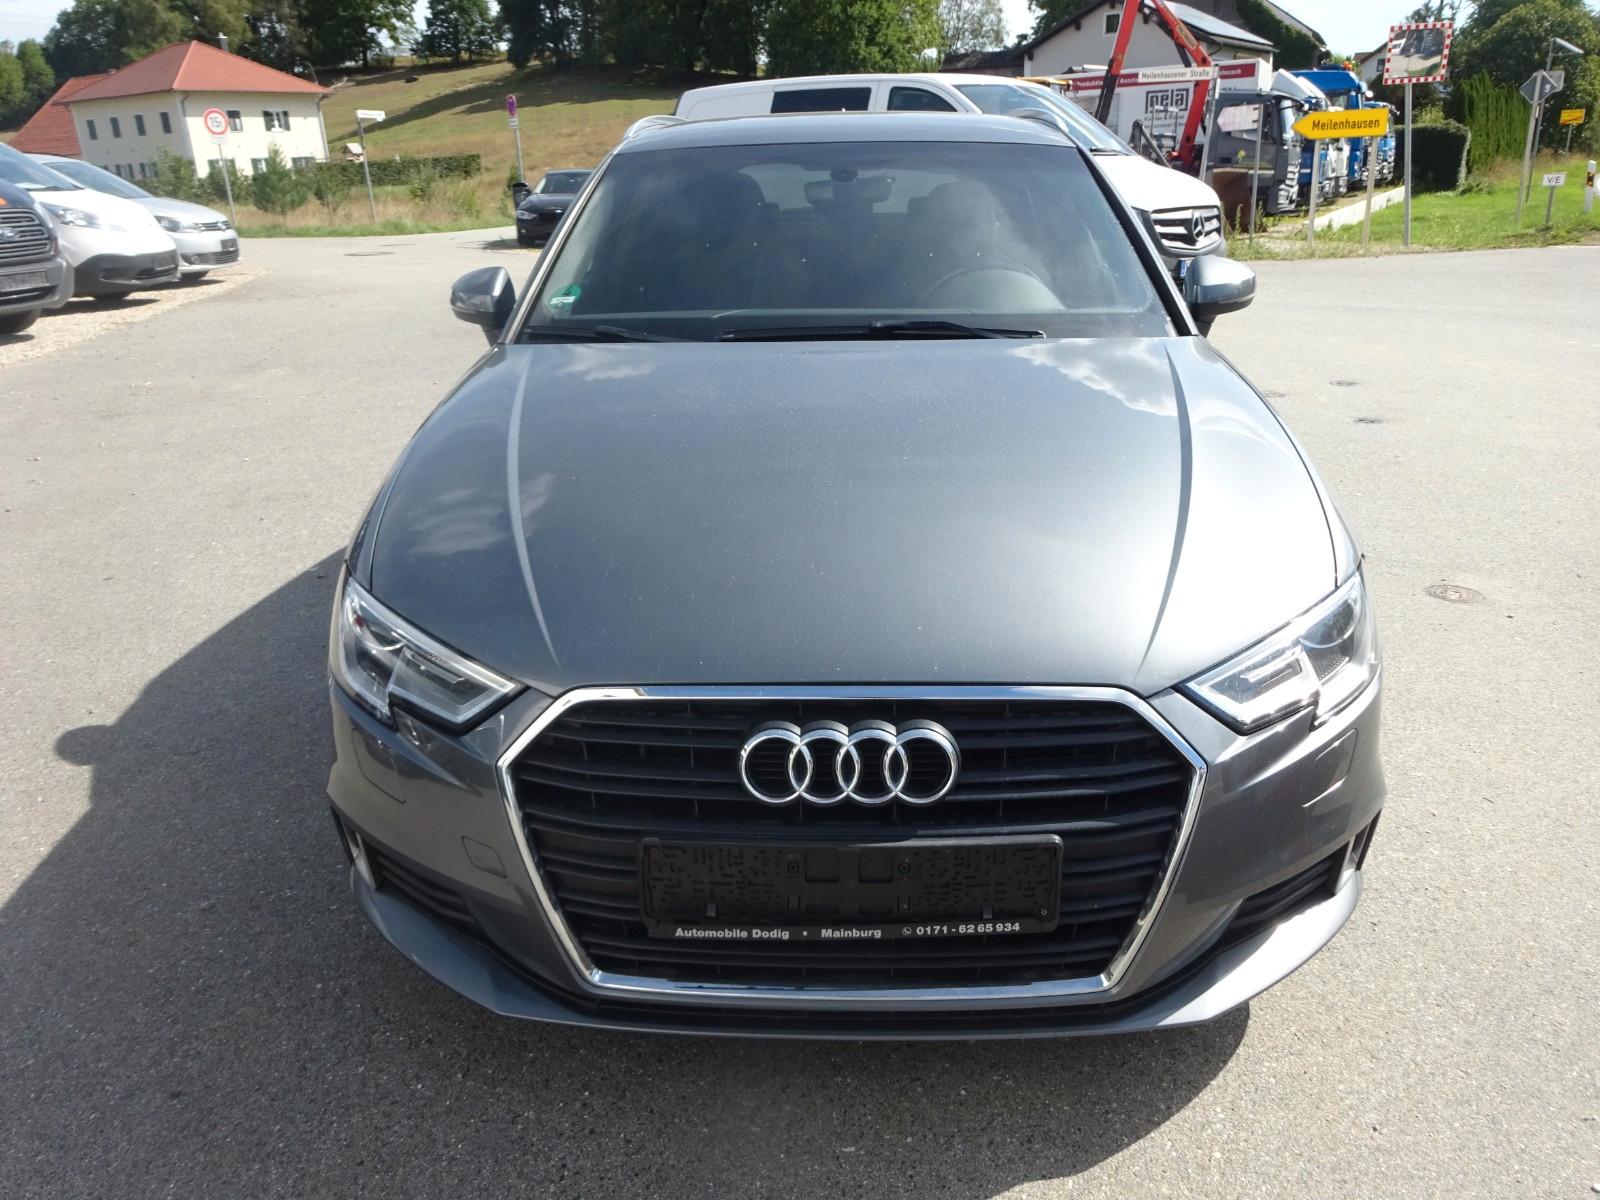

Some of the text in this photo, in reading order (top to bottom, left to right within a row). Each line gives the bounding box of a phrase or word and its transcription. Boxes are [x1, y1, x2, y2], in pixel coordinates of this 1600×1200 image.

[1141, 69, 1209, 80] Meilenhausener Straße
[1312, 119, 1380, 131] Meilenhausen
[675, 927, 748, 938] Automobile
[752, 928, 790, 940] Dodig
[821, 928, 882, 939] Mainburg
